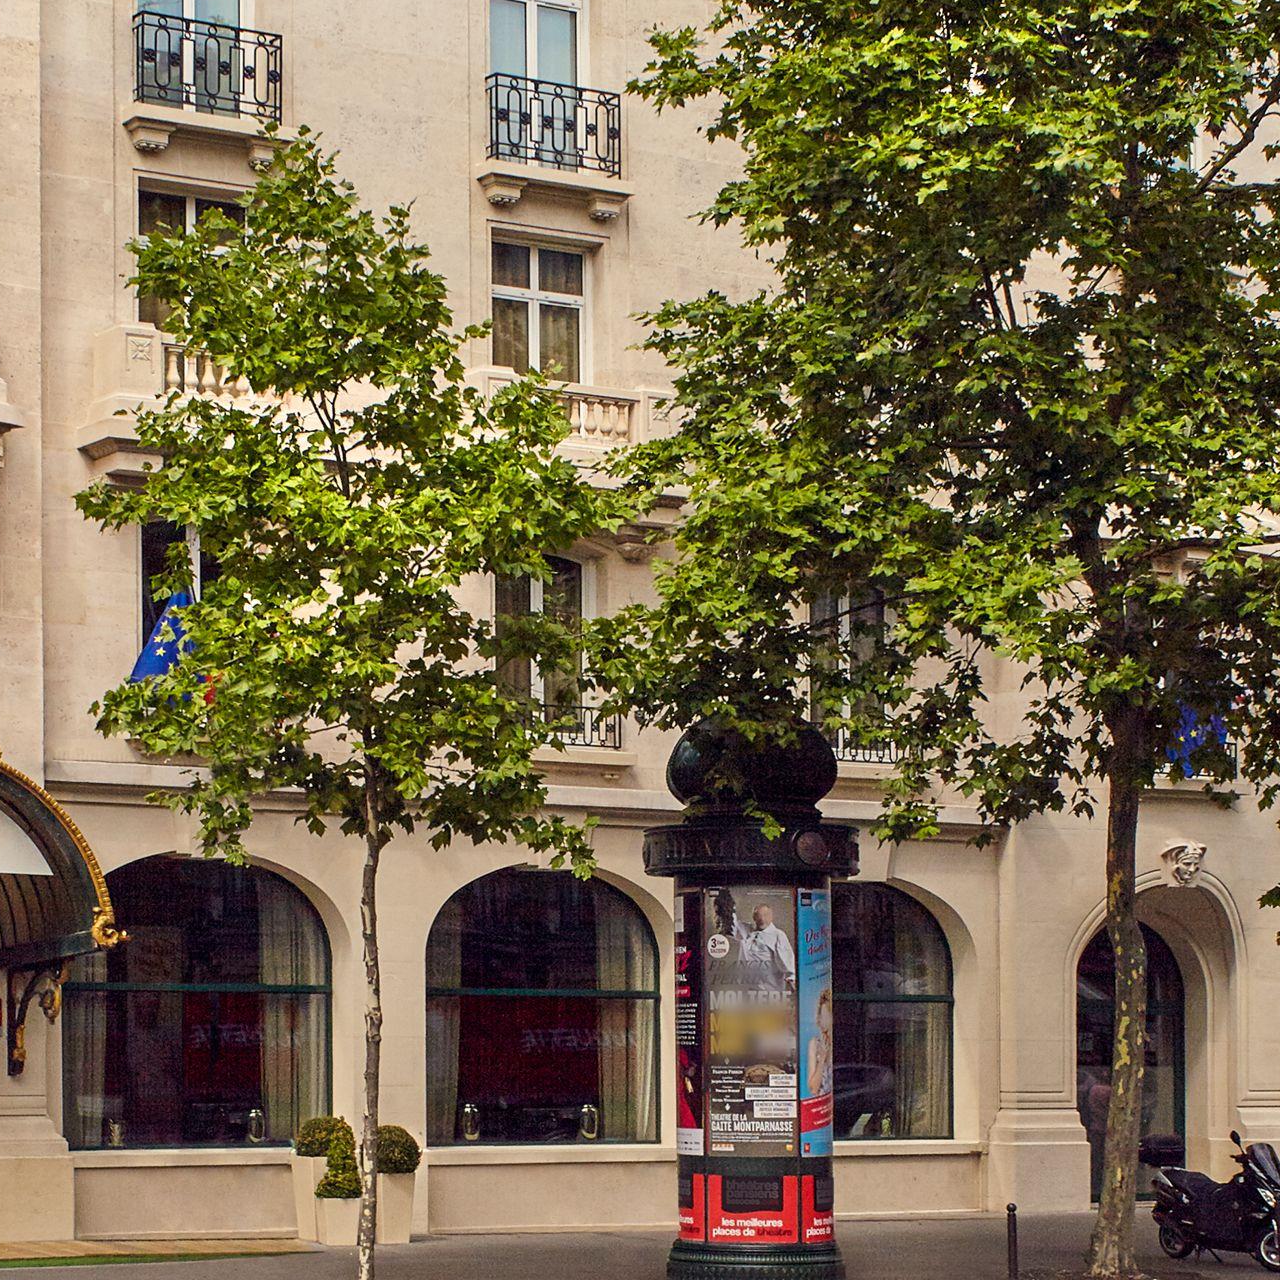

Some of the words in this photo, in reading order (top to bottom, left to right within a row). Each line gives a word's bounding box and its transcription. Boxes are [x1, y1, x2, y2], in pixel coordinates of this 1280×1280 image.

[733, 1121, 794, 1132] MONTPARNASSE
[721, 1217, 734, 1225] les
[736, 1217, 783, 1227] meilleures
[712, 1227, 741, 1239] places
[742, 1227, 755, 1236] de
